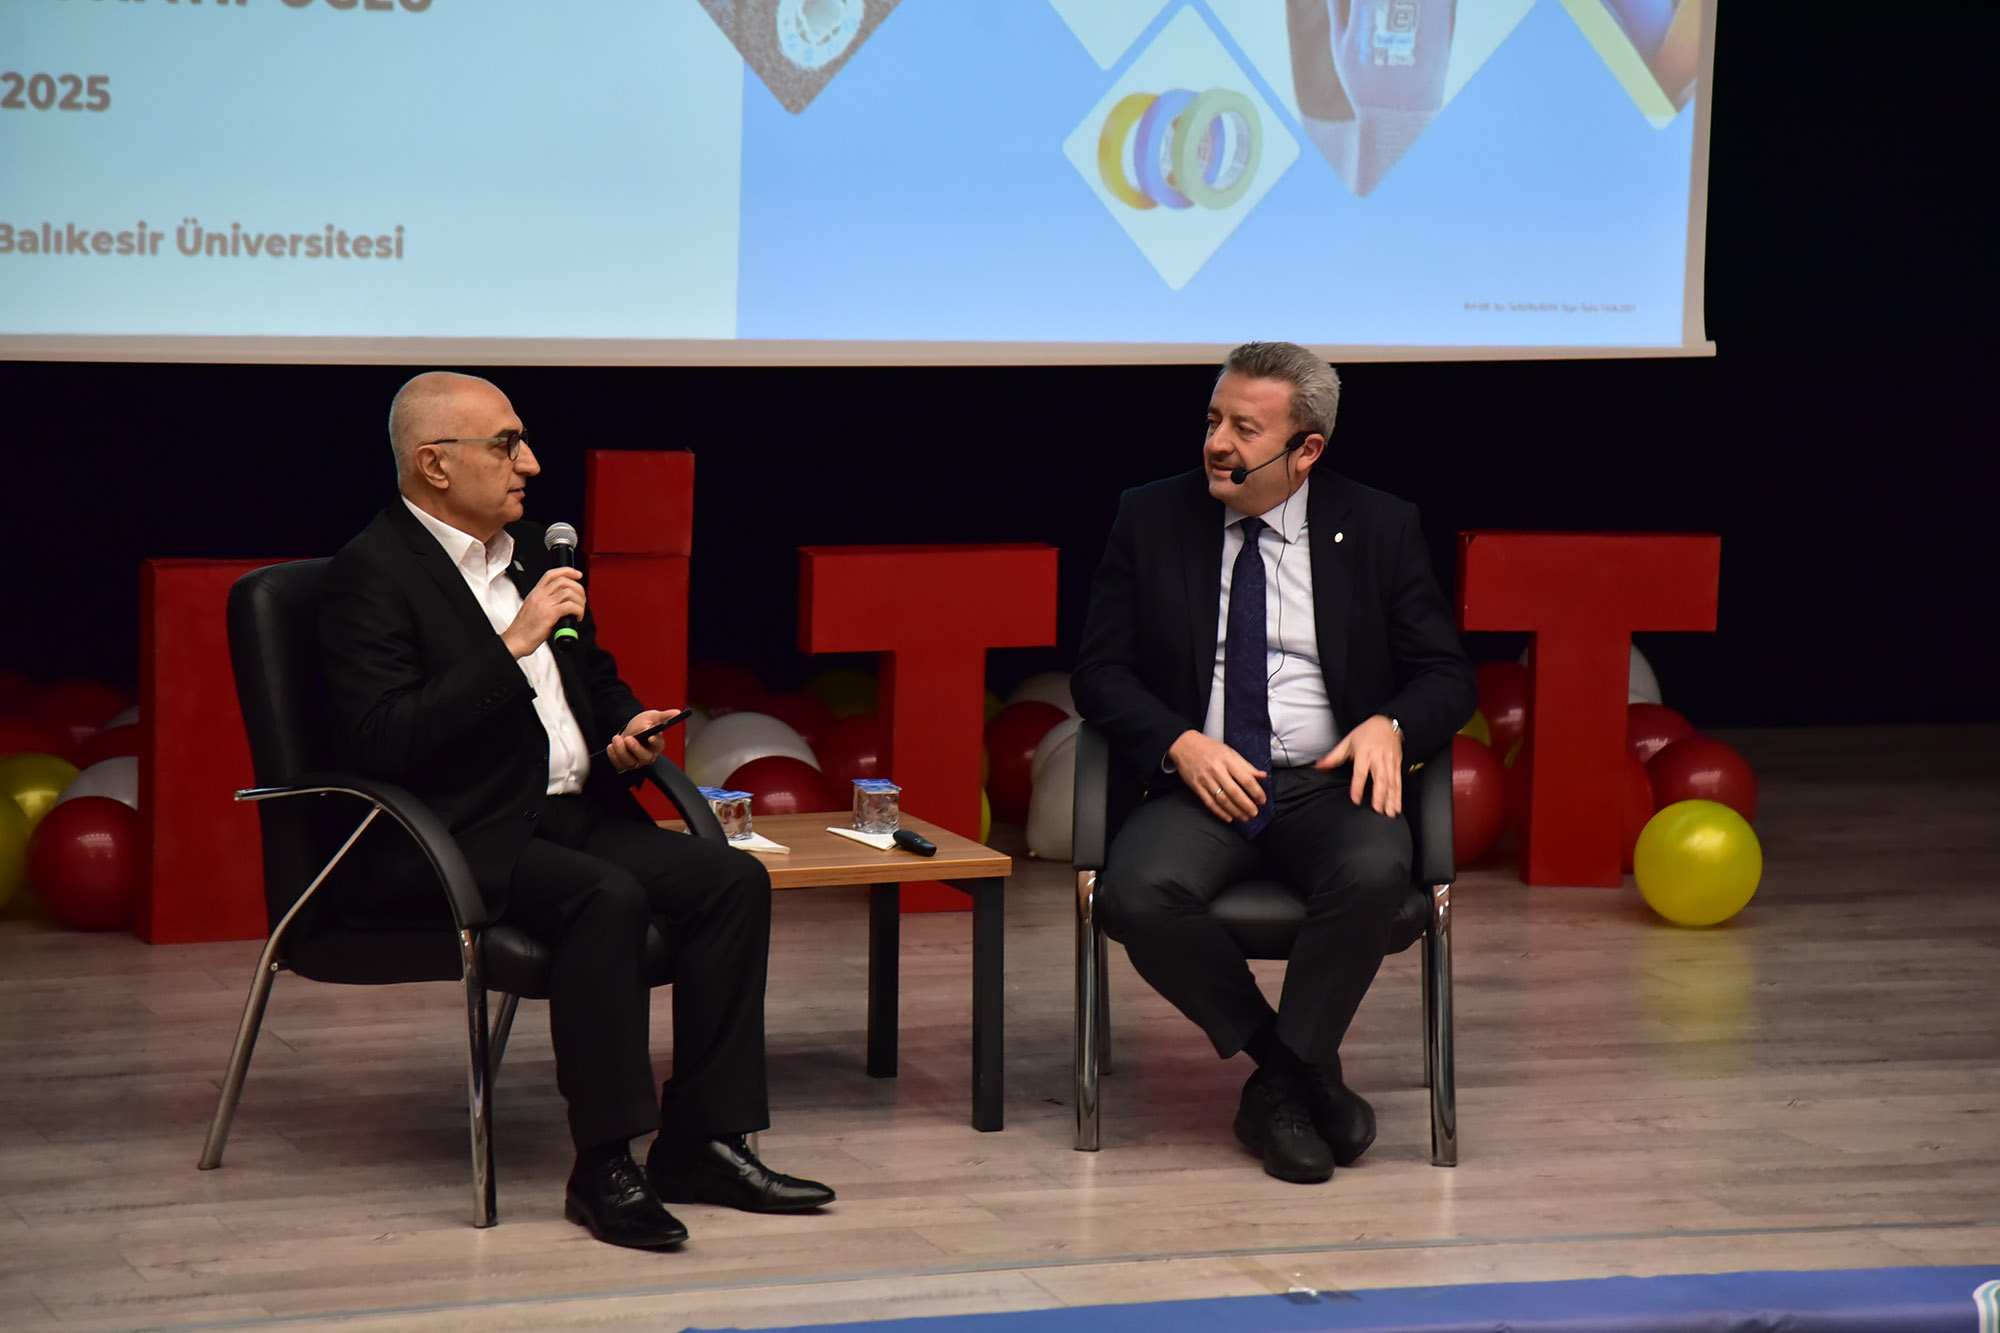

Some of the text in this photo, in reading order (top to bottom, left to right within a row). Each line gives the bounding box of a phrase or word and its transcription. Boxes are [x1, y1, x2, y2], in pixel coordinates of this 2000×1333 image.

[0, 72, 111, 112] 2025
[0, 217, 405, 260] Balıkesir Üniversitesi
